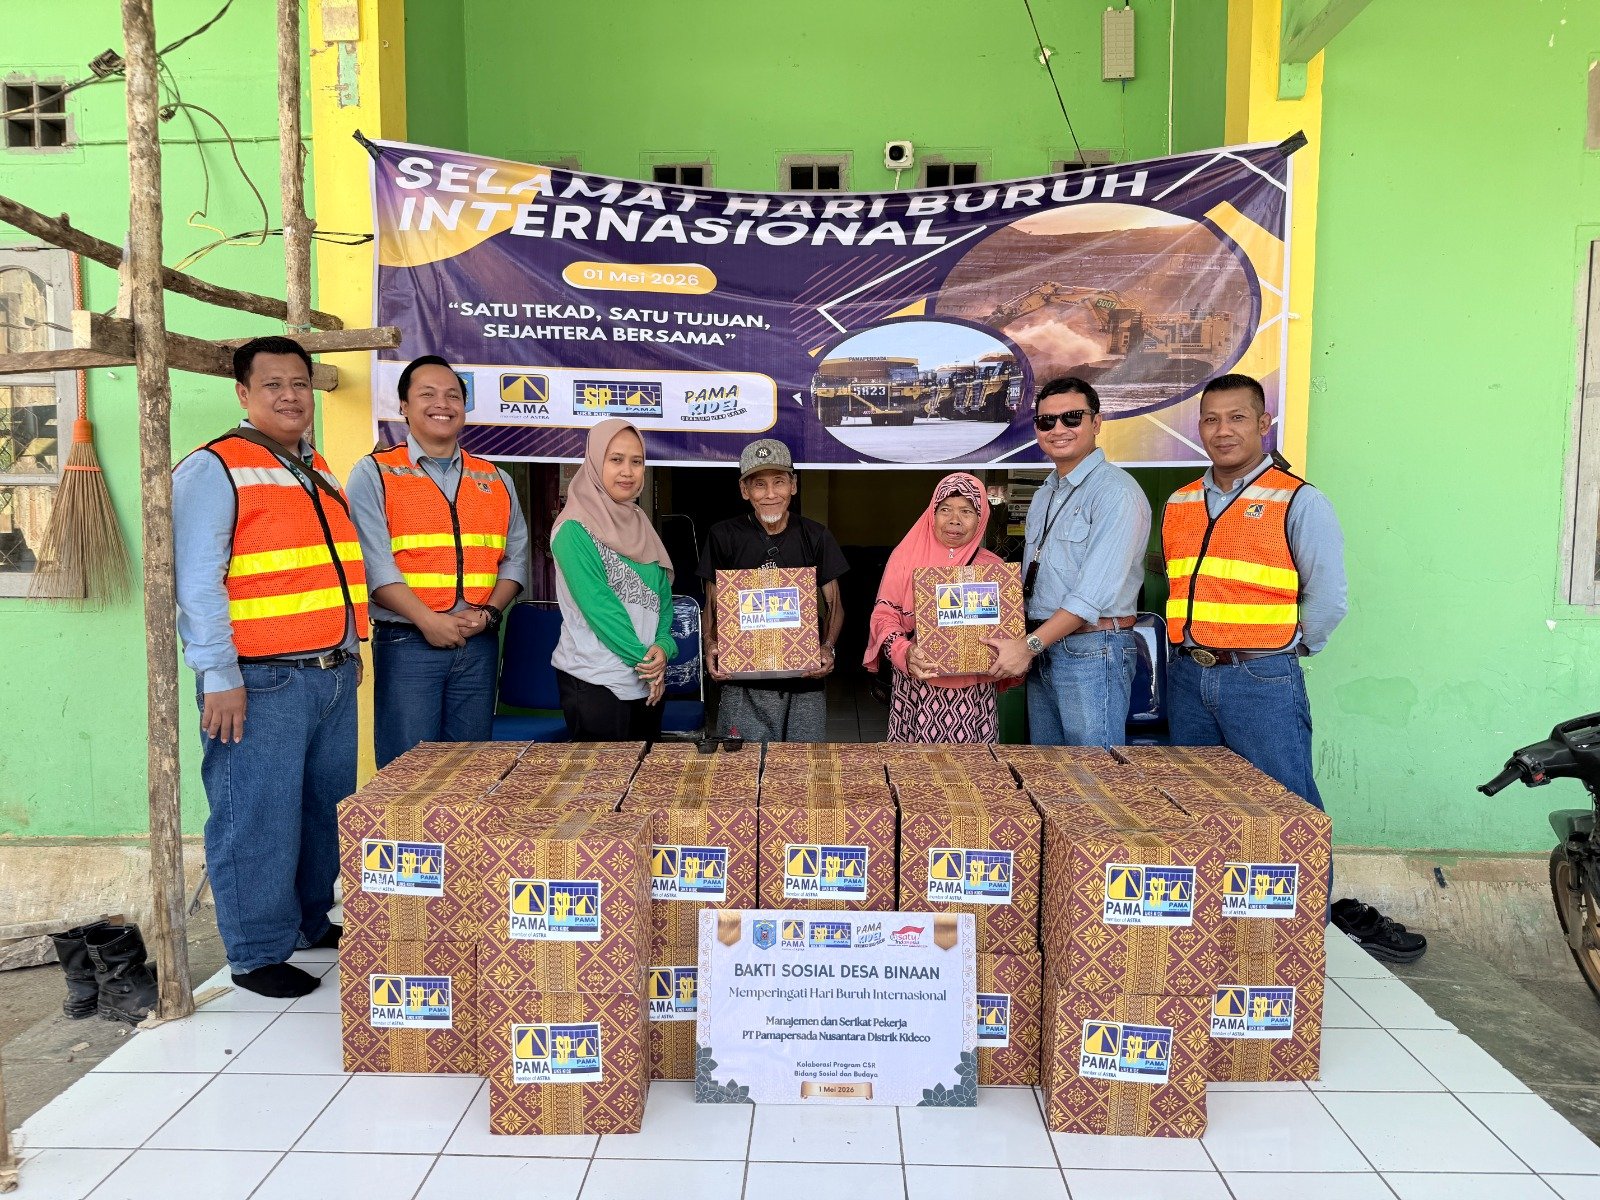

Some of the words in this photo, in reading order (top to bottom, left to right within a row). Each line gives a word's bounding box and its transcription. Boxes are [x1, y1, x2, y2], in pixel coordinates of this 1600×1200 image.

[395, 157, 711, 212] SELAMAT
[721, 193, 889, 219] HARI
[905, 171, 1149, 217] BURUH
[397, 197, 947, 246] INTERNASIONAL
[584, 268, 603, 281] 01
[610, 270, 650, 284] Mei
[652, 272, 700, 287] 2026
[522, 303, 602, 323] TEKAD,
[608, 306, 672, 324] SATU
[673, 311, 771, 331] TUJUAN,
[483, 324, 607, 342] SEJAHTERA
[584, 387, 612, 408] SP
[684, 385, 738, 403] PAMA
[500, 403, 550, 414] PAMA
[741, 614, 766, 624] PAMA
[938, 610, 963, 620] PAMA
[363, 872, 395, 886] PAMA
[651, 879, 677, 891] AMA
[786, 878, 818, 891] PAMA
[929, 881, 962, 893] PAMA
[1150, 877, 1165, 906] SP
[554, 892, 570, 921] SP
[1105, 902, 1141, 915] PAMA
[1222, 896, 1247, 909] AMA
[511, 917, 546, 930] PAMA
[856, 922, 881, 935] PAMA
[734, 964, 777, 977] BAKTI
[782, 964, 835, 978] SOSIAL
[840, 965, 879, 979] DESA
[884, 966, 940, 980] BINAAN
[729, 987, 808, 1001] Memperingati
[810, 988, 834, 999] Hari
[836, 988, 870, 1000] Buruh
[872, 989, 947, 1001] Internasional
[372, 1007, 404, 1019] PAMA
[650, 1001, 674, 1012] AMA
[766, 1016, 819, 1028] Manajemen
[820, 1016, 838, 1026] dan
[840, 1016, 872, 1027] Serikat
[873, 1017, 907, 1030] Pekerja
[1212, 1018, 1245, 1030] PAMA
[742, 1031, 755, 1040] PT
[755, 1031, 818, 1042] Pamapersada
[819, 1032, 866, 1041] Nusantara
[867, 1032, 898, 1042] Distrik
[899, 1033, 931, 1043] Kideco
[1126, 1035, 1142, 1063] SP
[515, 1061, 550, 1073] PAMA
[833, 1062, 861, 1070] Program
[1082, 1055, 1117, 1070] PAMA
[794, 1070, 817, 1078] Bidang
[853, 1071, 878, 1079] Budaya
